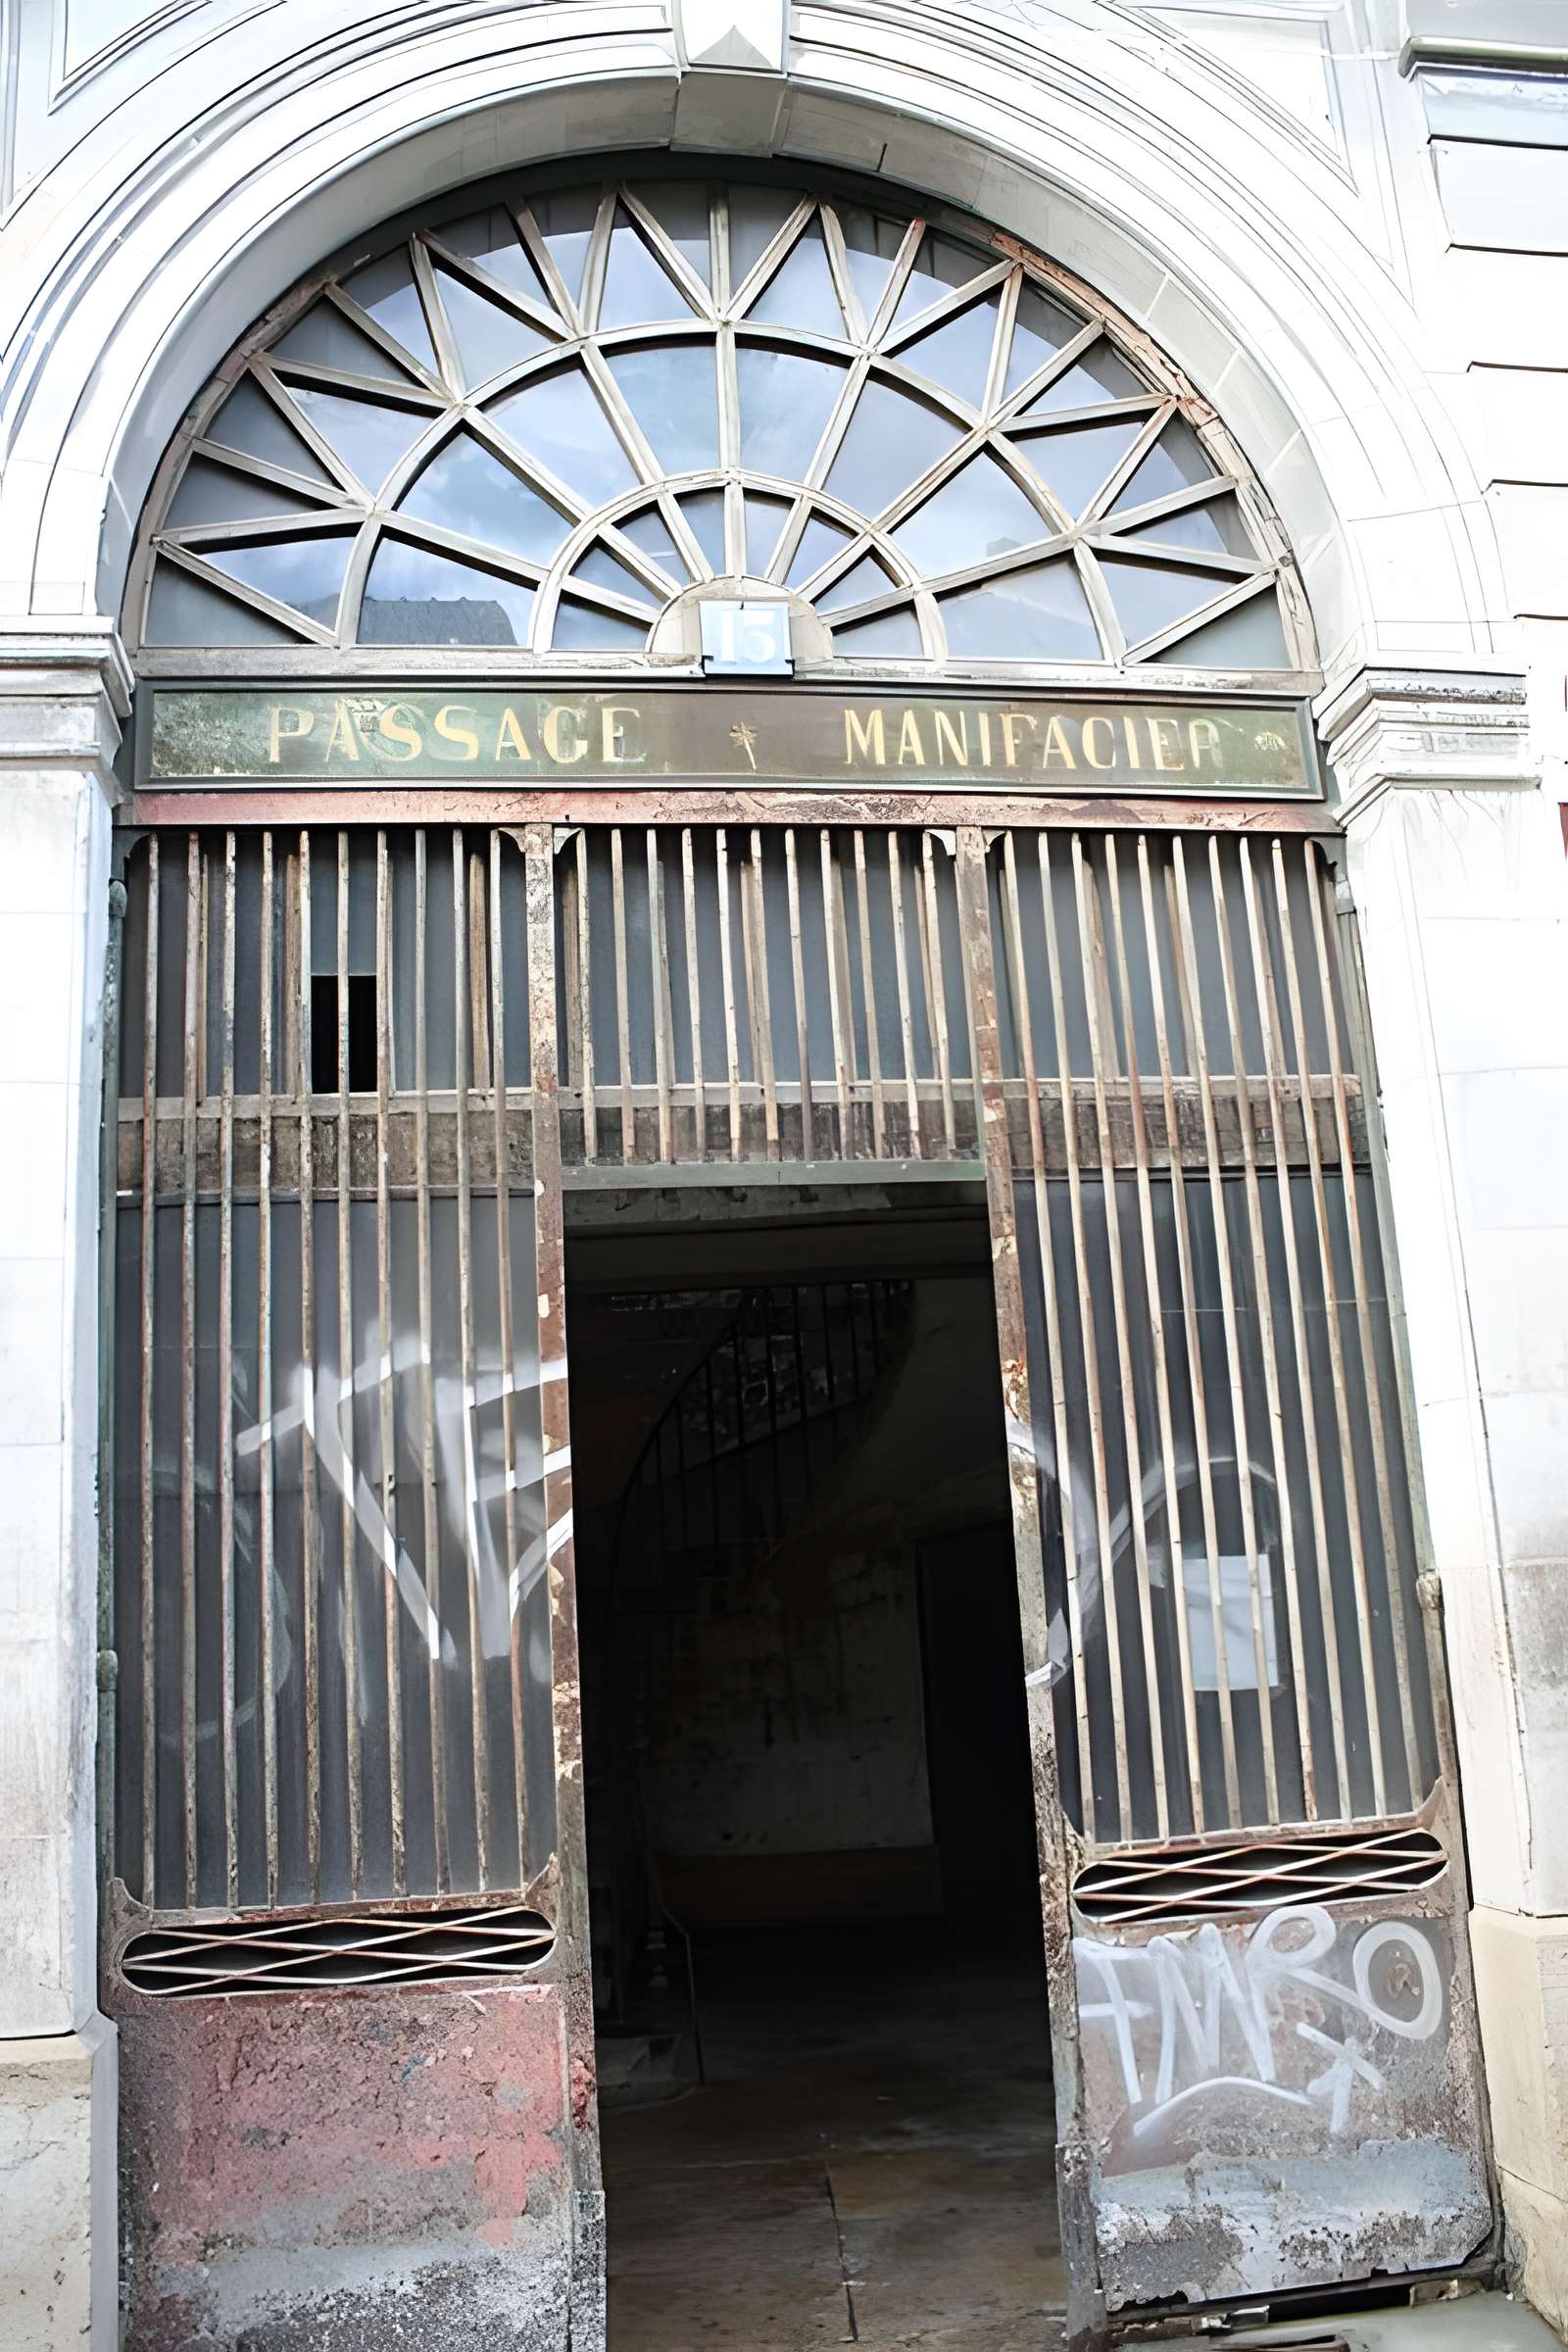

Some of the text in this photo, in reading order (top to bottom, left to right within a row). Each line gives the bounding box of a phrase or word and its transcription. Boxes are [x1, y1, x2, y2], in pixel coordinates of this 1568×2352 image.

[719, 610, 776, 663] 15
[268, 702, 1224, 770] PASSAGE MANIFACIER
